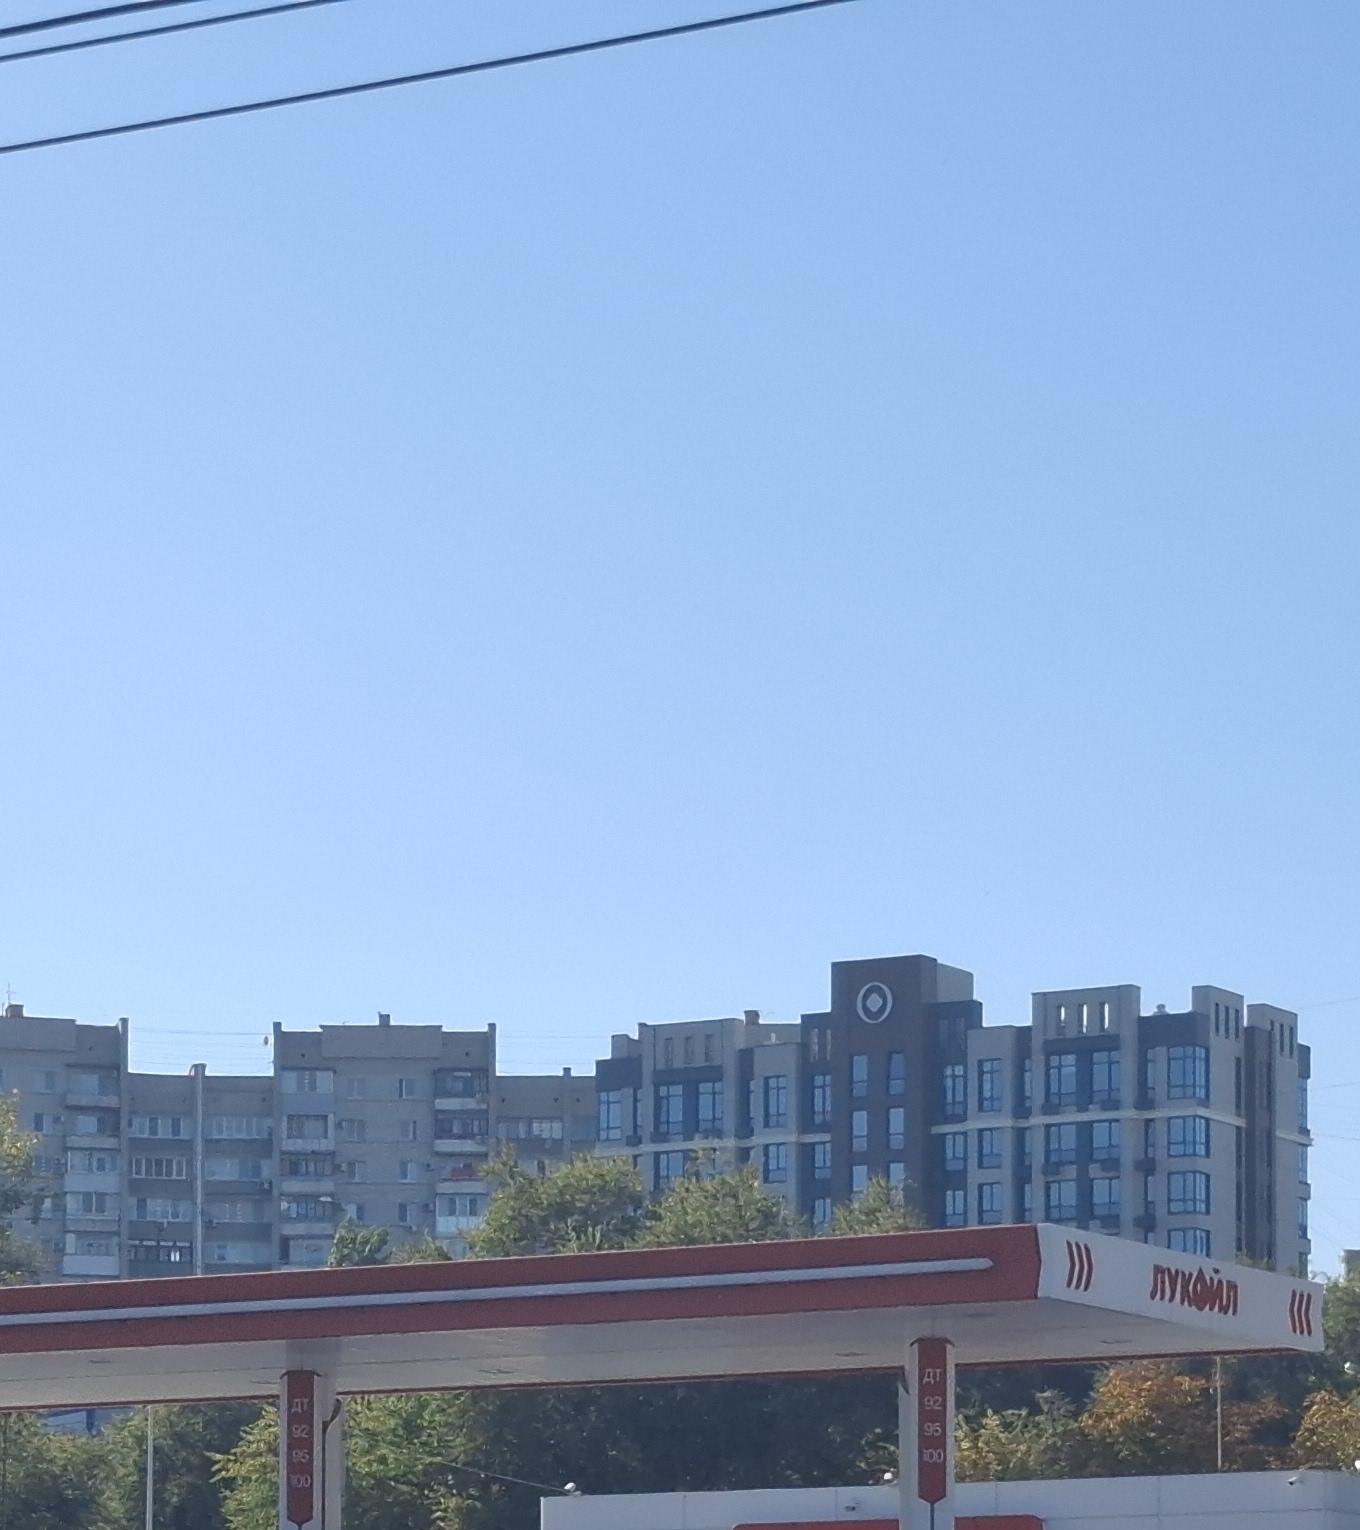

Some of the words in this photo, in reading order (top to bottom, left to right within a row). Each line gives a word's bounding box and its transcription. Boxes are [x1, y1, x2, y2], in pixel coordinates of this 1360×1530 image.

[1150, 1264, 1238, 1316] ЛУКОЙЛ
[923, 1368, 941, 1384] ДТ
[291, 1399, 308, 1413] ДТ
[924, 1396, 942, 1410] 92
[292, 1425, 309, 1438] 92
[924, 1422, 942, 1436] 95
[292, 1450, 310, 1463] 95
